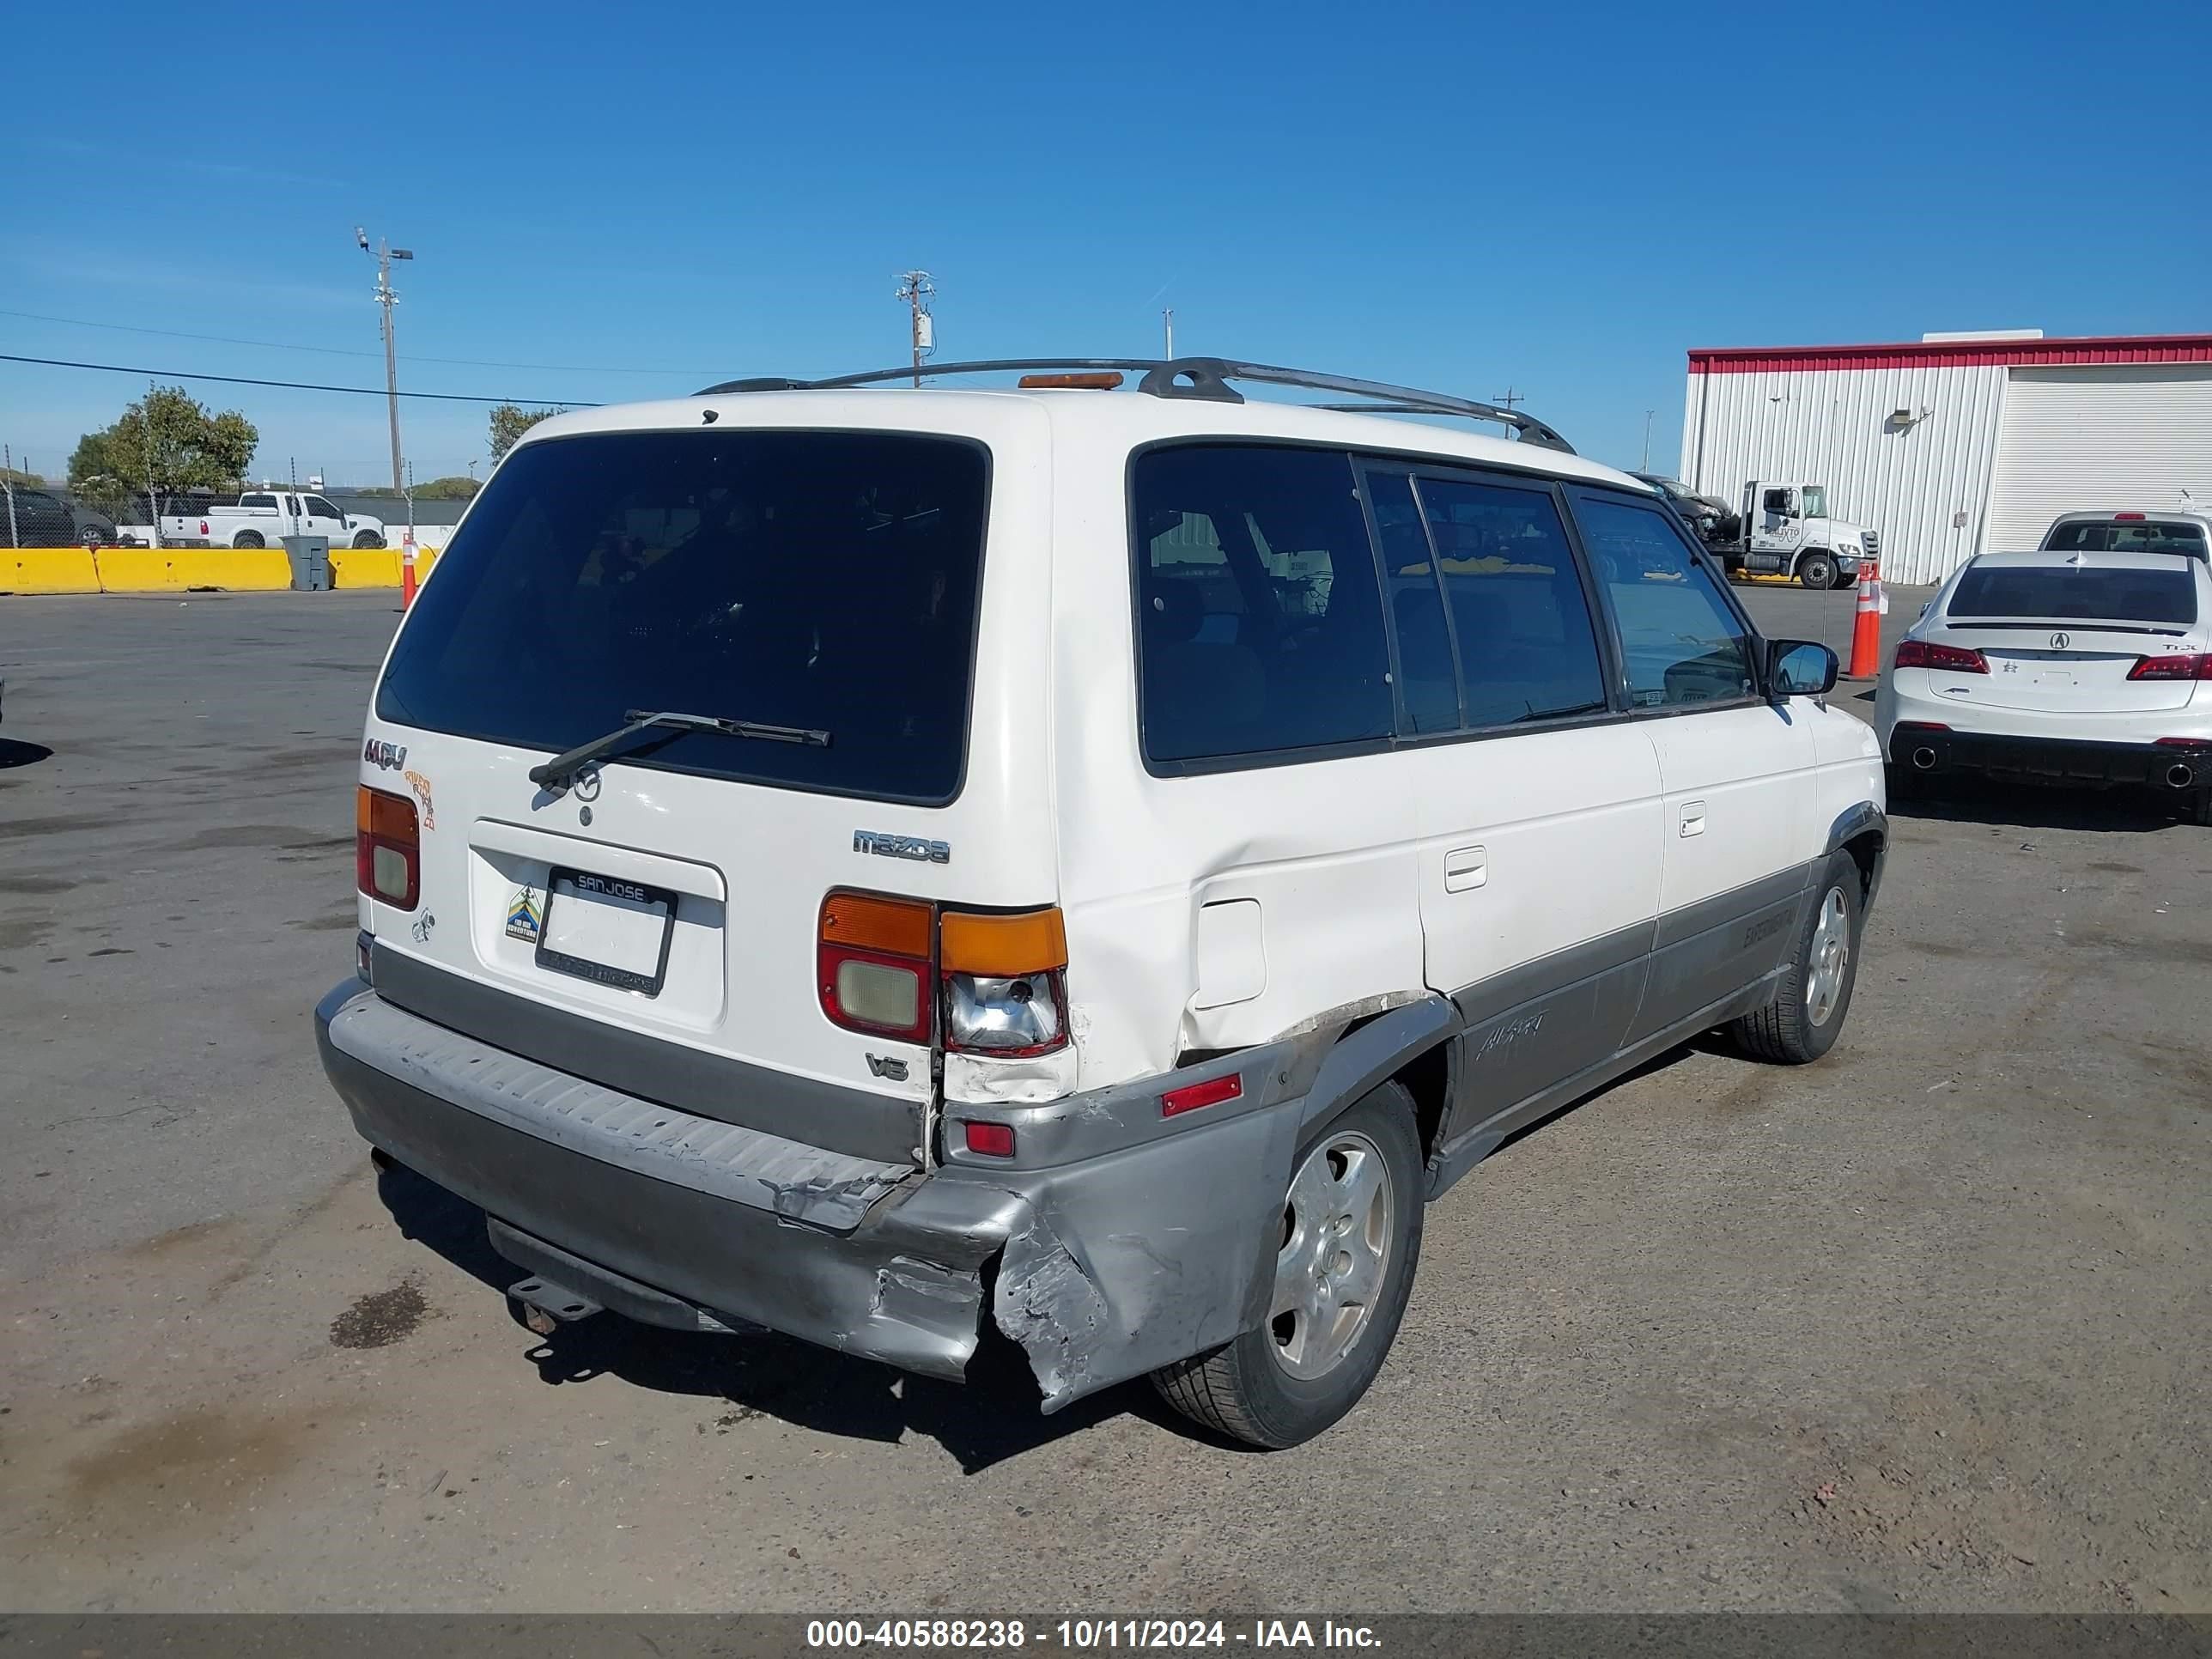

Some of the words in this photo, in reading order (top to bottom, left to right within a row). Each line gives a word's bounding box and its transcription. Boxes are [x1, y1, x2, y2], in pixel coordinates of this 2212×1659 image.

[364, 738, 407, 770] MPV
[578, 875, 605, 891] SAN
[606, 882, 644, 901] JOSE
[866, 1053, 908, 1081] V6
